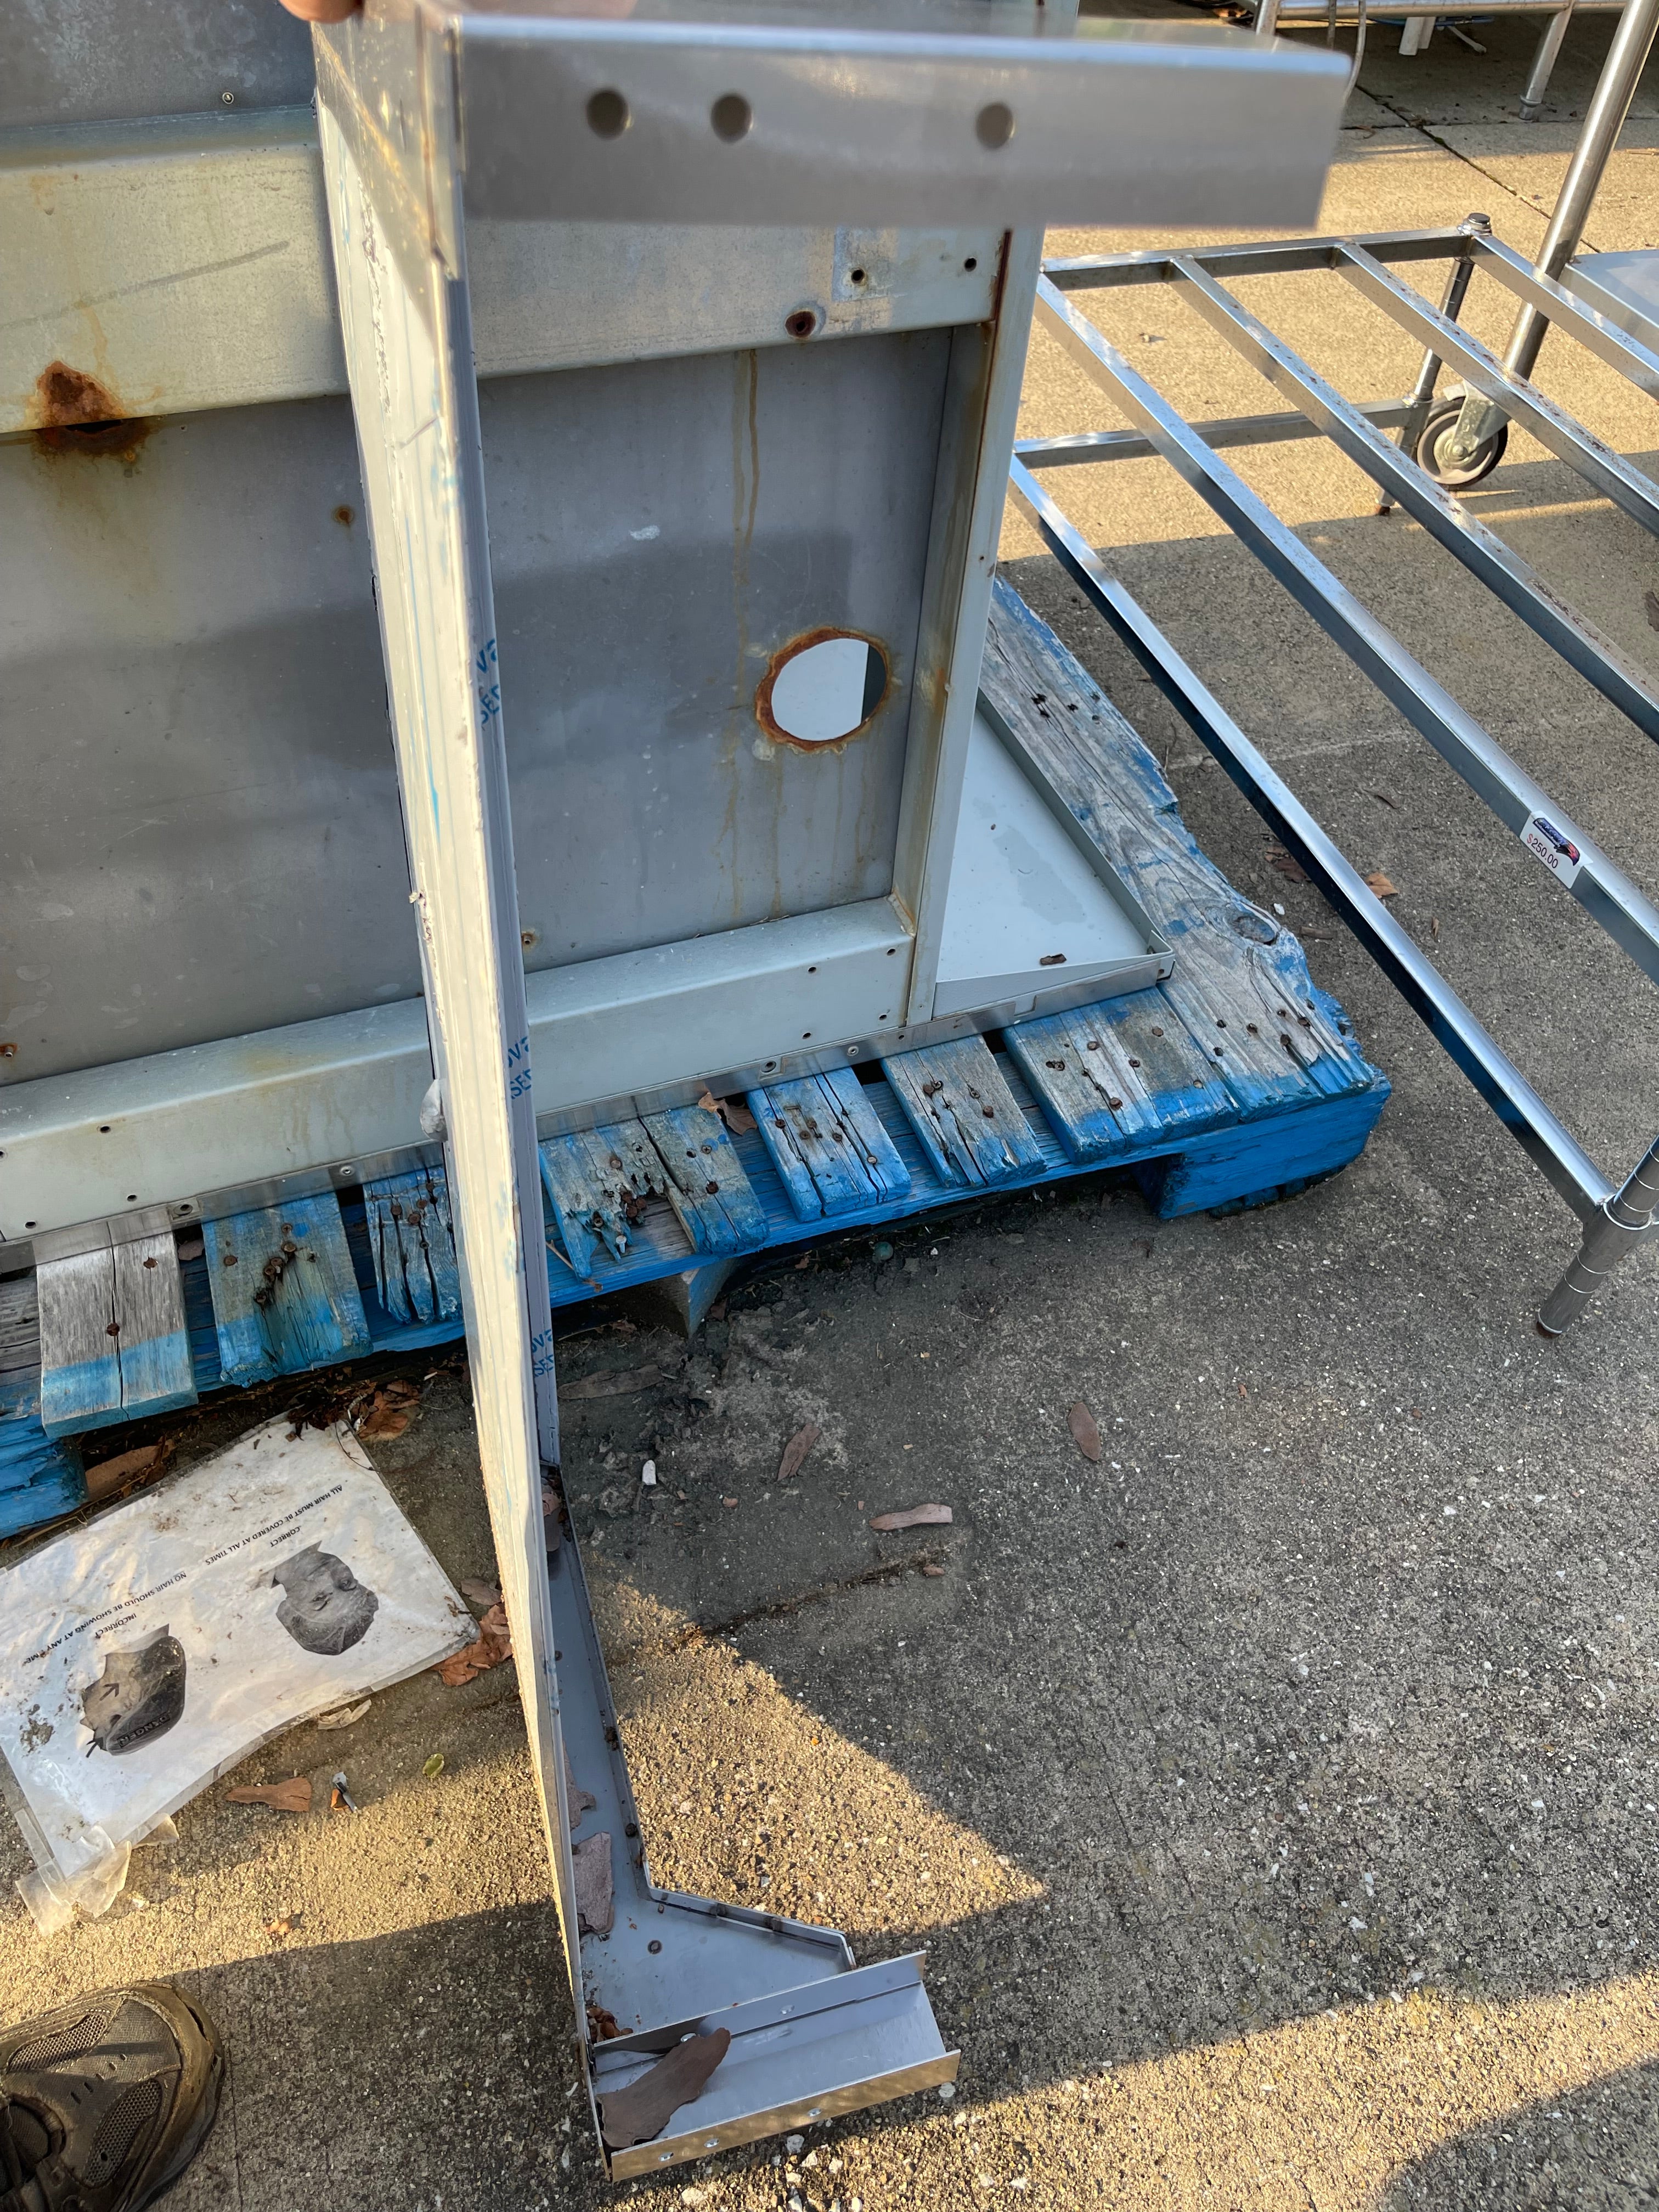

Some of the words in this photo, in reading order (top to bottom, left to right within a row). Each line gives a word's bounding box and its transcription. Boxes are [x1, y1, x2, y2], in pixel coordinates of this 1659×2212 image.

[1526, 833, 1559, 868] $250.00
[330, 1485, 342, 1494] ALL
[314, 1492, 331, 1505] HAIR
[294, 1502, 314, 1517] MUST
[284, 1514, 294, 1522] BE
[252, 1519, 284, 1540] COVERED
[242, 1537, 251, 1546] AT
[270, 1526, 300, 1548] CORRECT
[228, 1542, 240, 1553] ALL
[205, 1550, 228, 1565] TIMES
[174, 1571, 187, 1582] NO
[155, 1578, 174, 1592] HAIR
[125, 1589, 155, 1606] SHOULD
[113, 1604, 123, 1612] BE
[75, 1609, 112, 1633] SHOWING
[95, 1612, 137, 1638] INCORRECT
[64, 1631, 73, 1640] AT
[47, 1638, 62, 1651] ANY
